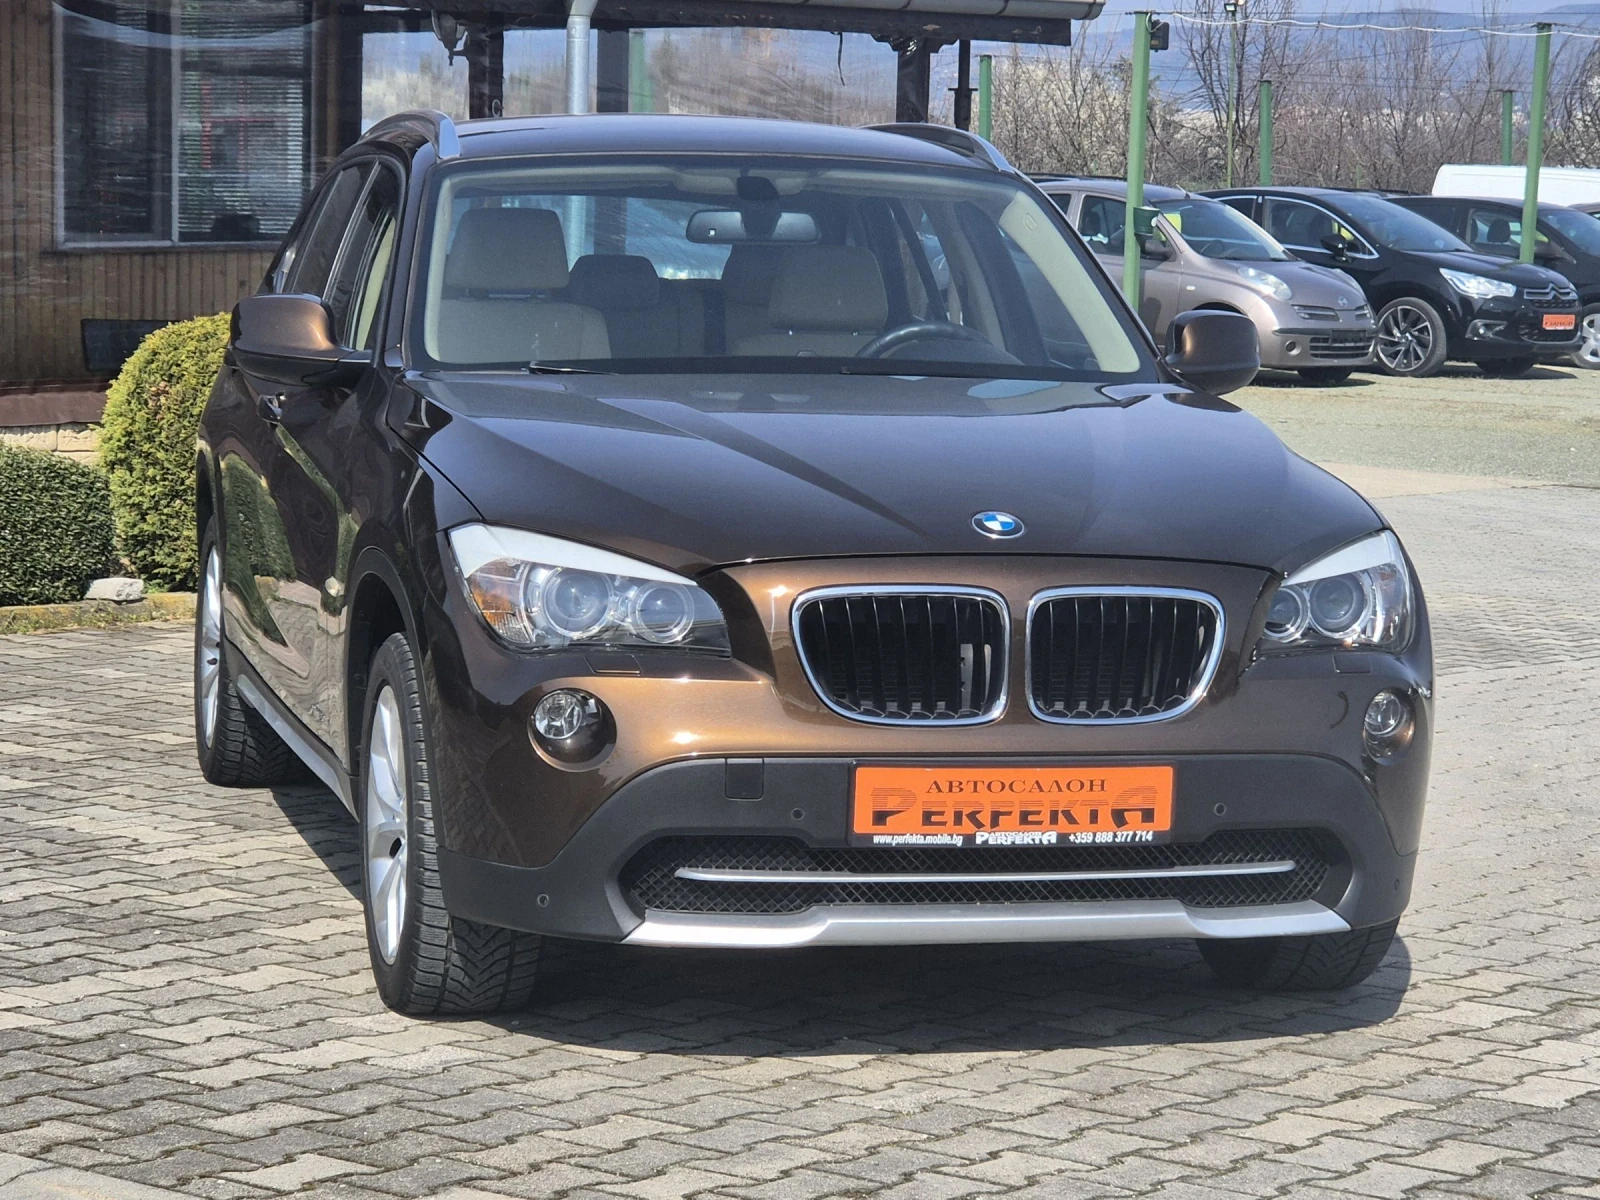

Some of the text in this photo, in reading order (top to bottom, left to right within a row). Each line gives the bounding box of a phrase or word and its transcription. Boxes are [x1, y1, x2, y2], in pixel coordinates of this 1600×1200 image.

[925, 779, 1107, 794] АВТОСАЛОН
[870, 785, 1158, 830] PERFEKTA
[873, 832, 963, 847] www.perfekta.mobile.bg
[975, 831, 1058, 845] PERFEKTA
[1068, 830, 1153, 844] +359 888 377 714
